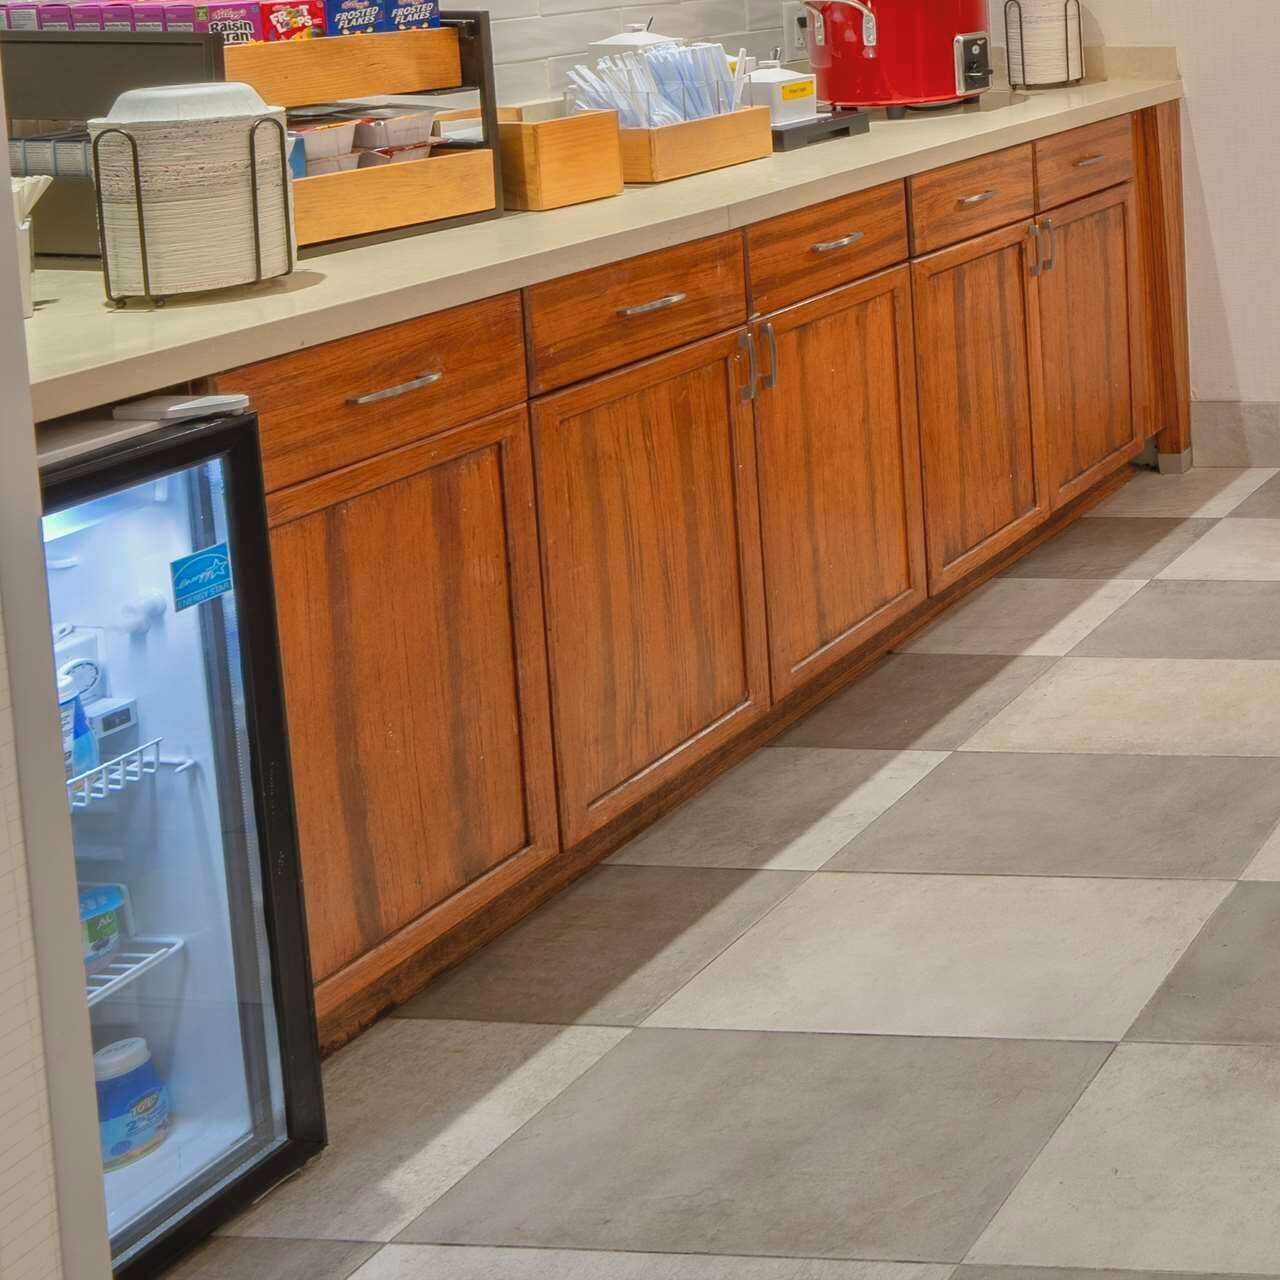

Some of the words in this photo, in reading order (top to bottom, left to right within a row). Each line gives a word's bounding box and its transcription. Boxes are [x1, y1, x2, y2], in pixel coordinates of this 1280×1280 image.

[334, 6, 379, 22] FROSTED
[391, 3, 434, 17] FROSTED
[338, 15, 376, 29] FLAKES
[394, 11, 431, 24] FLAKES
[209, 21, 253, 32] Raisin
[224, 32, 250, 42] ran
